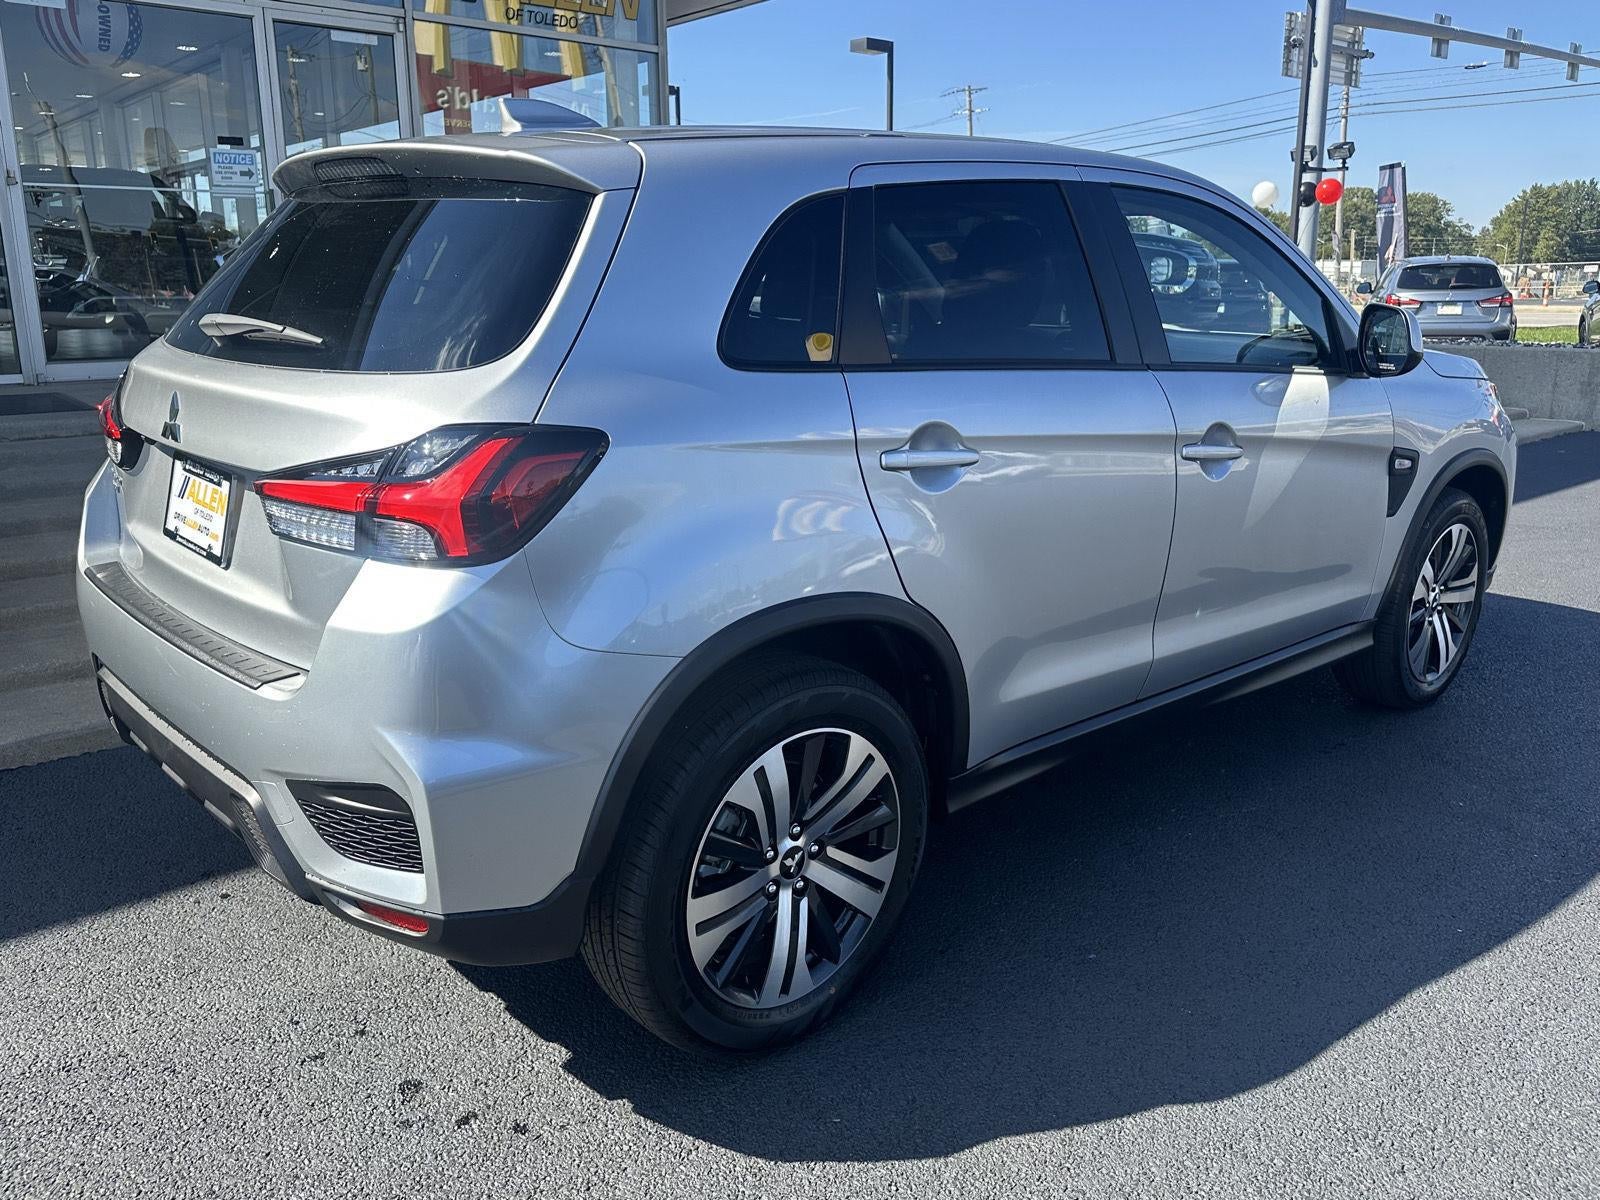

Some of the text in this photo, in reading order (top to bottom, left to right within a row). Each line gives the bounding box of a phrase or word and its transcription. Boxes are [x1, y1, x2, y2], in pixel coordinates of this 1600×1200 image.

[97, 5, 111, 52] OWNED
[505, 7, 523, 20] OF
[526, 10, 578, 29] TOLEDO
[215, 153, 252, 164] NOTICE
[186, 478, 228, 517] ALLEN
